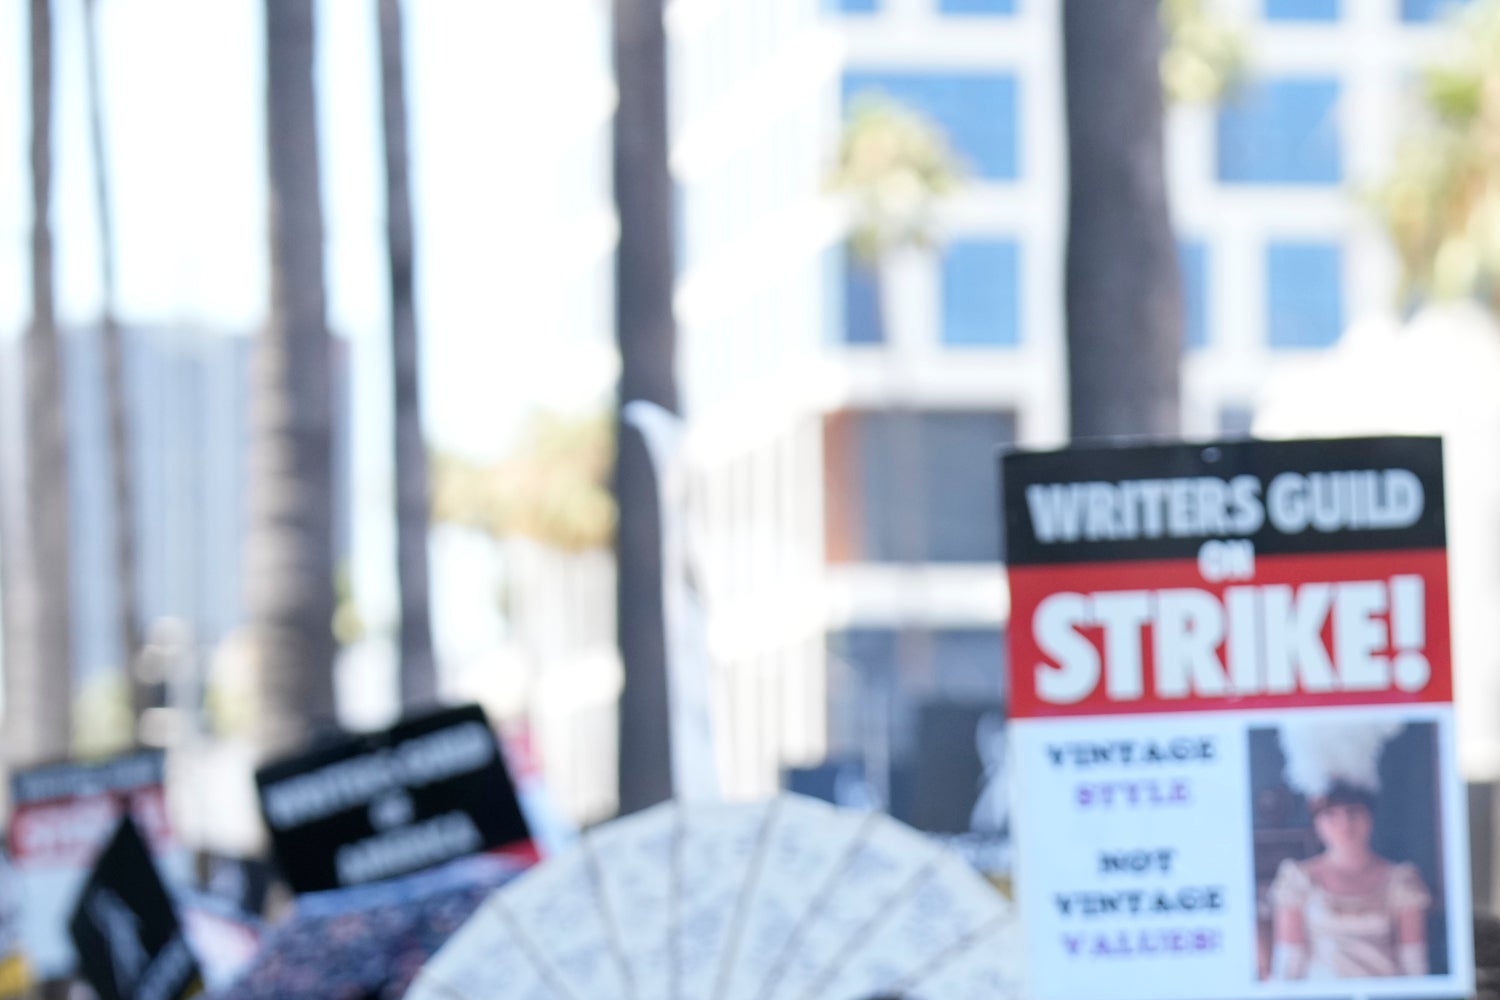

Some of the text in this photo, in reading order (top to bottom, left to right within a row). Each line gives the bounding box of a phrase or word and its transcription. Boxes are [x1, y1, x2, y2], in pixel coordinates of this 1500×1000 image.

[1026, 467, 1426, 544] WRITERS GUILD
[1198, 538, 1256, 583] ON
[1031, 573, 1431, 704] STRIKE!
[1046, 736, 1217, 769] VINTAGE
[1073, 779, 1190, 809] STYLE
[1097, 849, 1175, 877] NOT
[1053, 885, 1227, 919] VINTAGE
